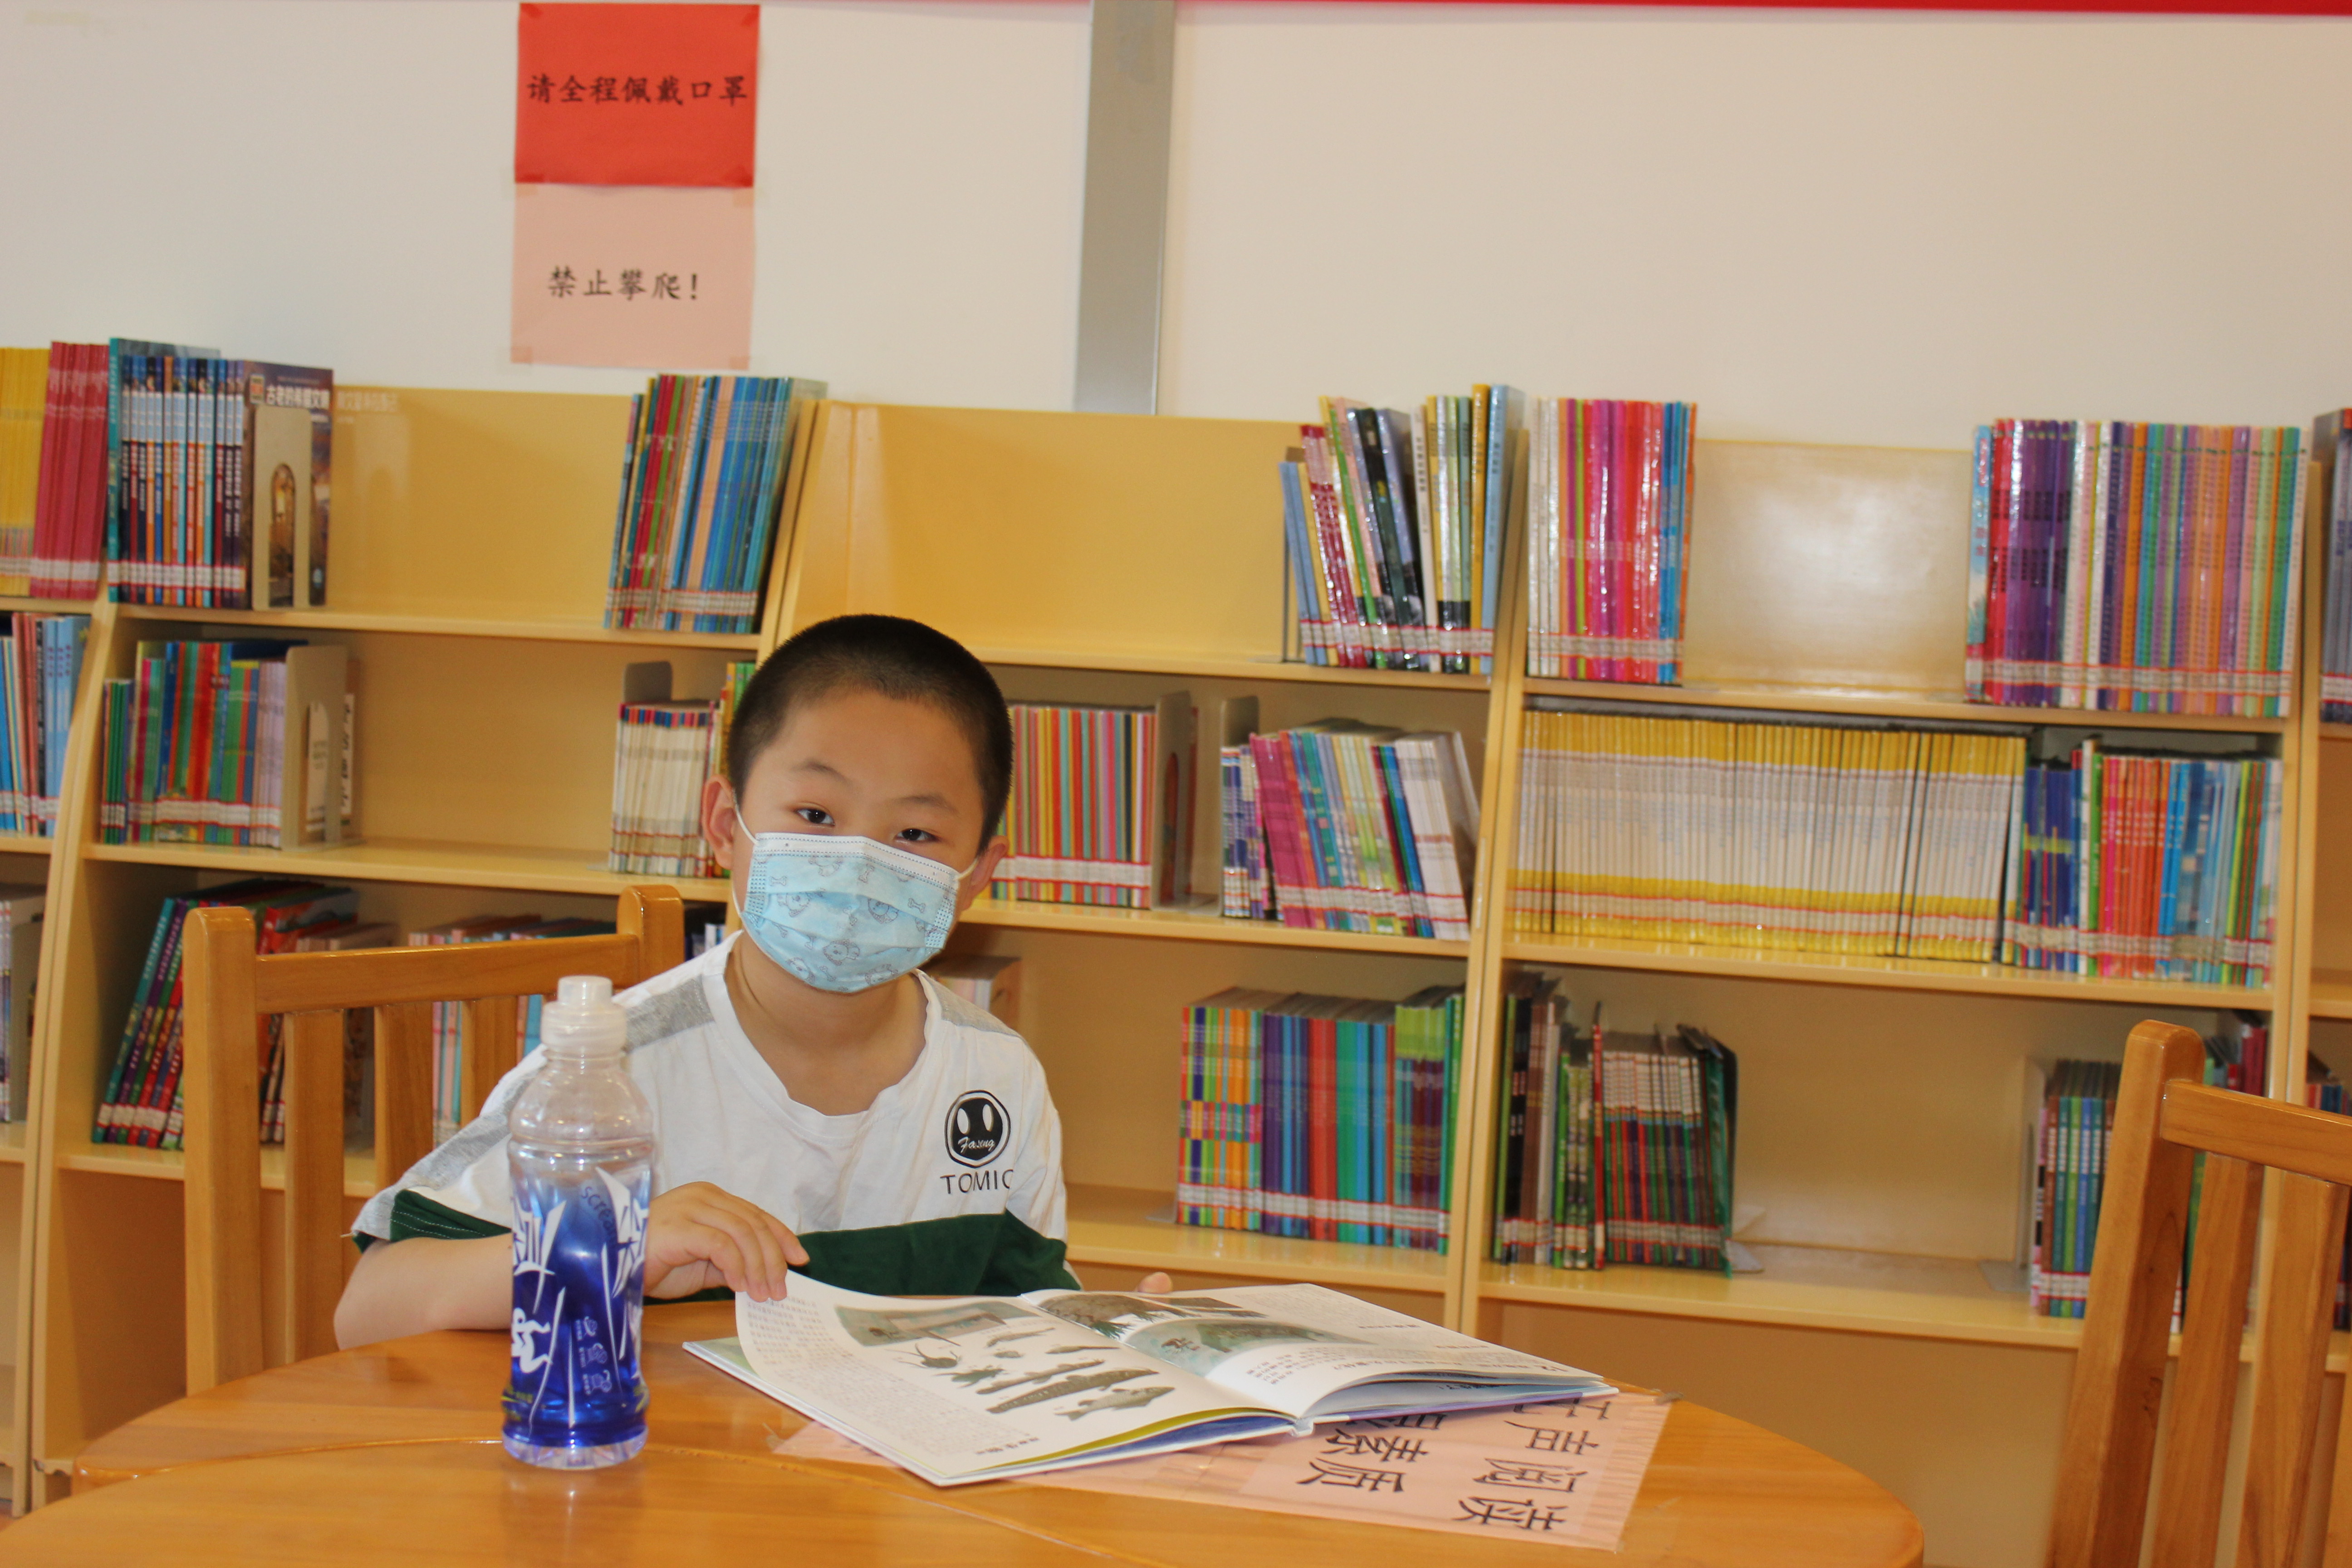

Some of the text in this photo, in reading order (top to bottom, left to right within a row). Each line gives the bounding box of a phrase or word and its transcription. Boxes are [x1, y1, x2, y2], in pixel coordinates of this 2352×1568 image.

[526, 73, 748, 107] 请全程佩戴口罩
[548, 265, 698, 301] 禁止攀爬!
